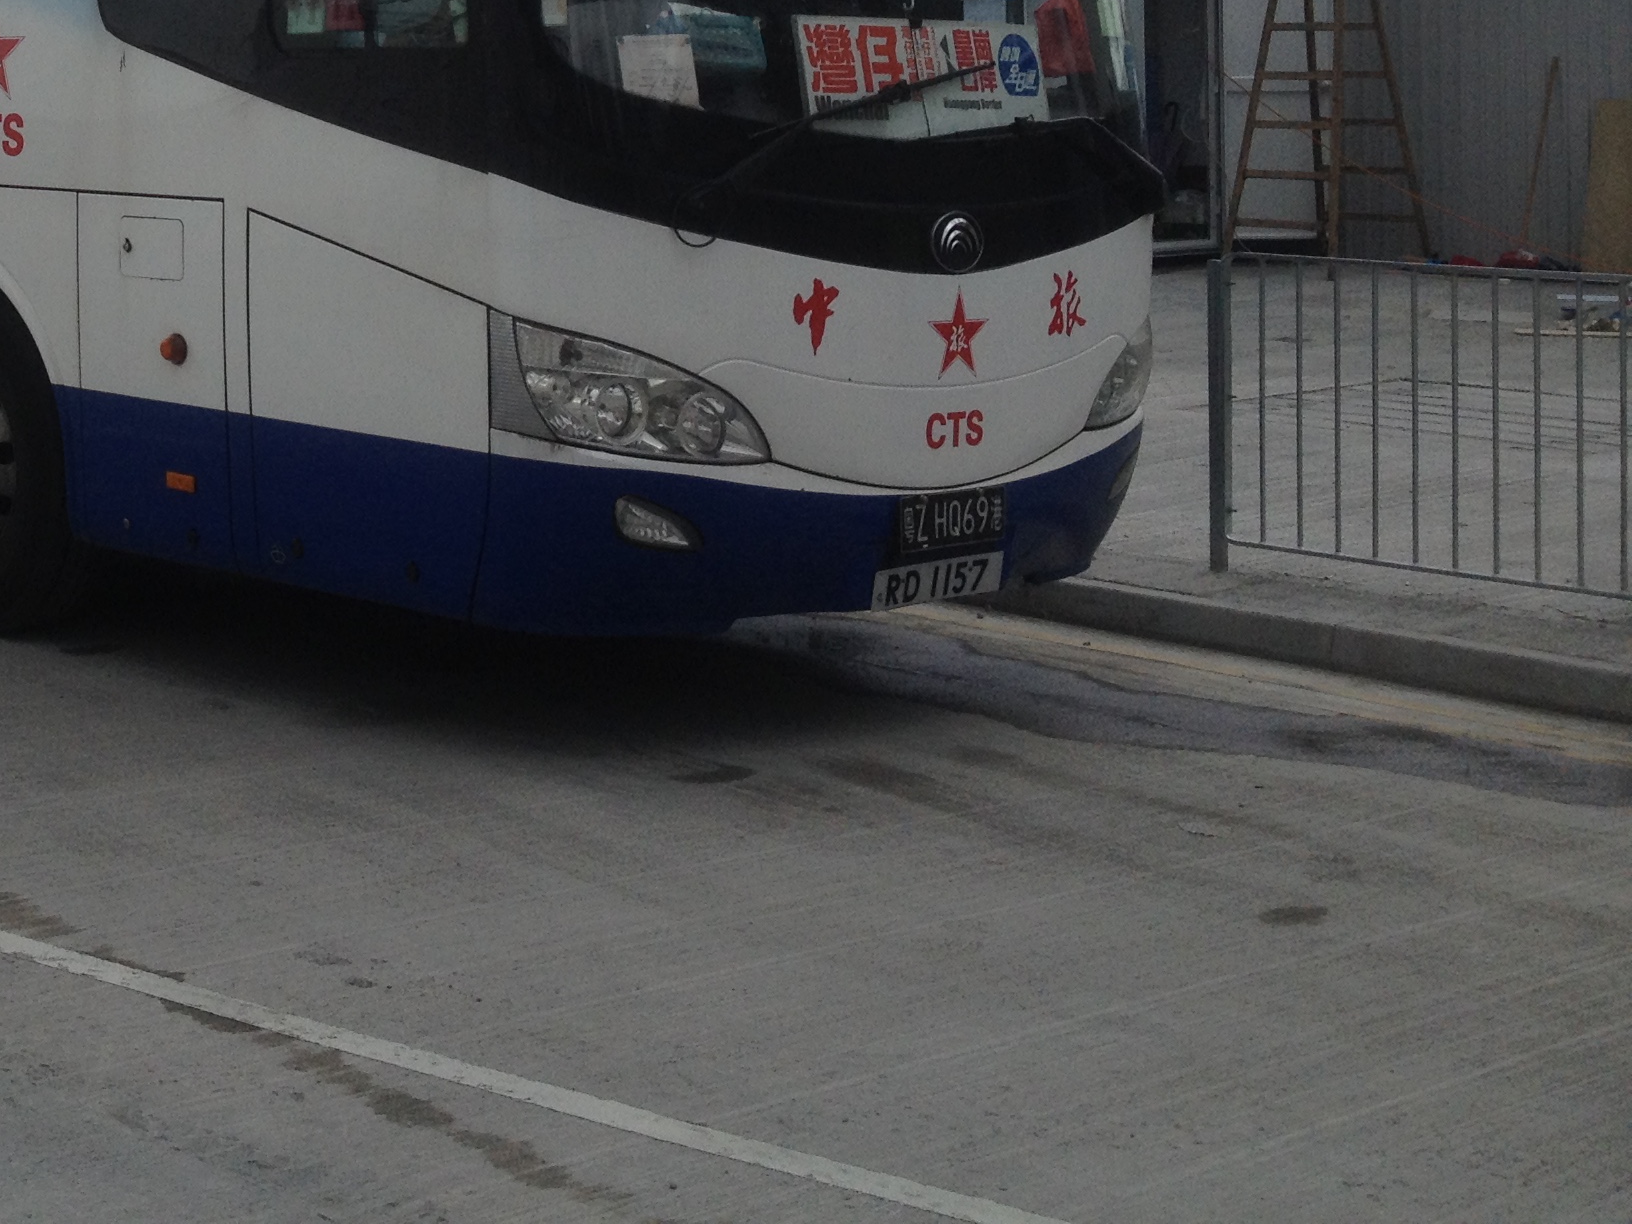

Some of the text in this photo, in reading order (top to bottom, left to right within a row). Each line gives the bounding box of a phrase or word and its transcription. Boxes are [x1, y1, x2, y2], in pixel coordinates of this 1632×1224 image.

[793, 277, 840, 356] 中
[926, 409, 984, 449] CTS
[886, 558, 989, 607] RD 1157
